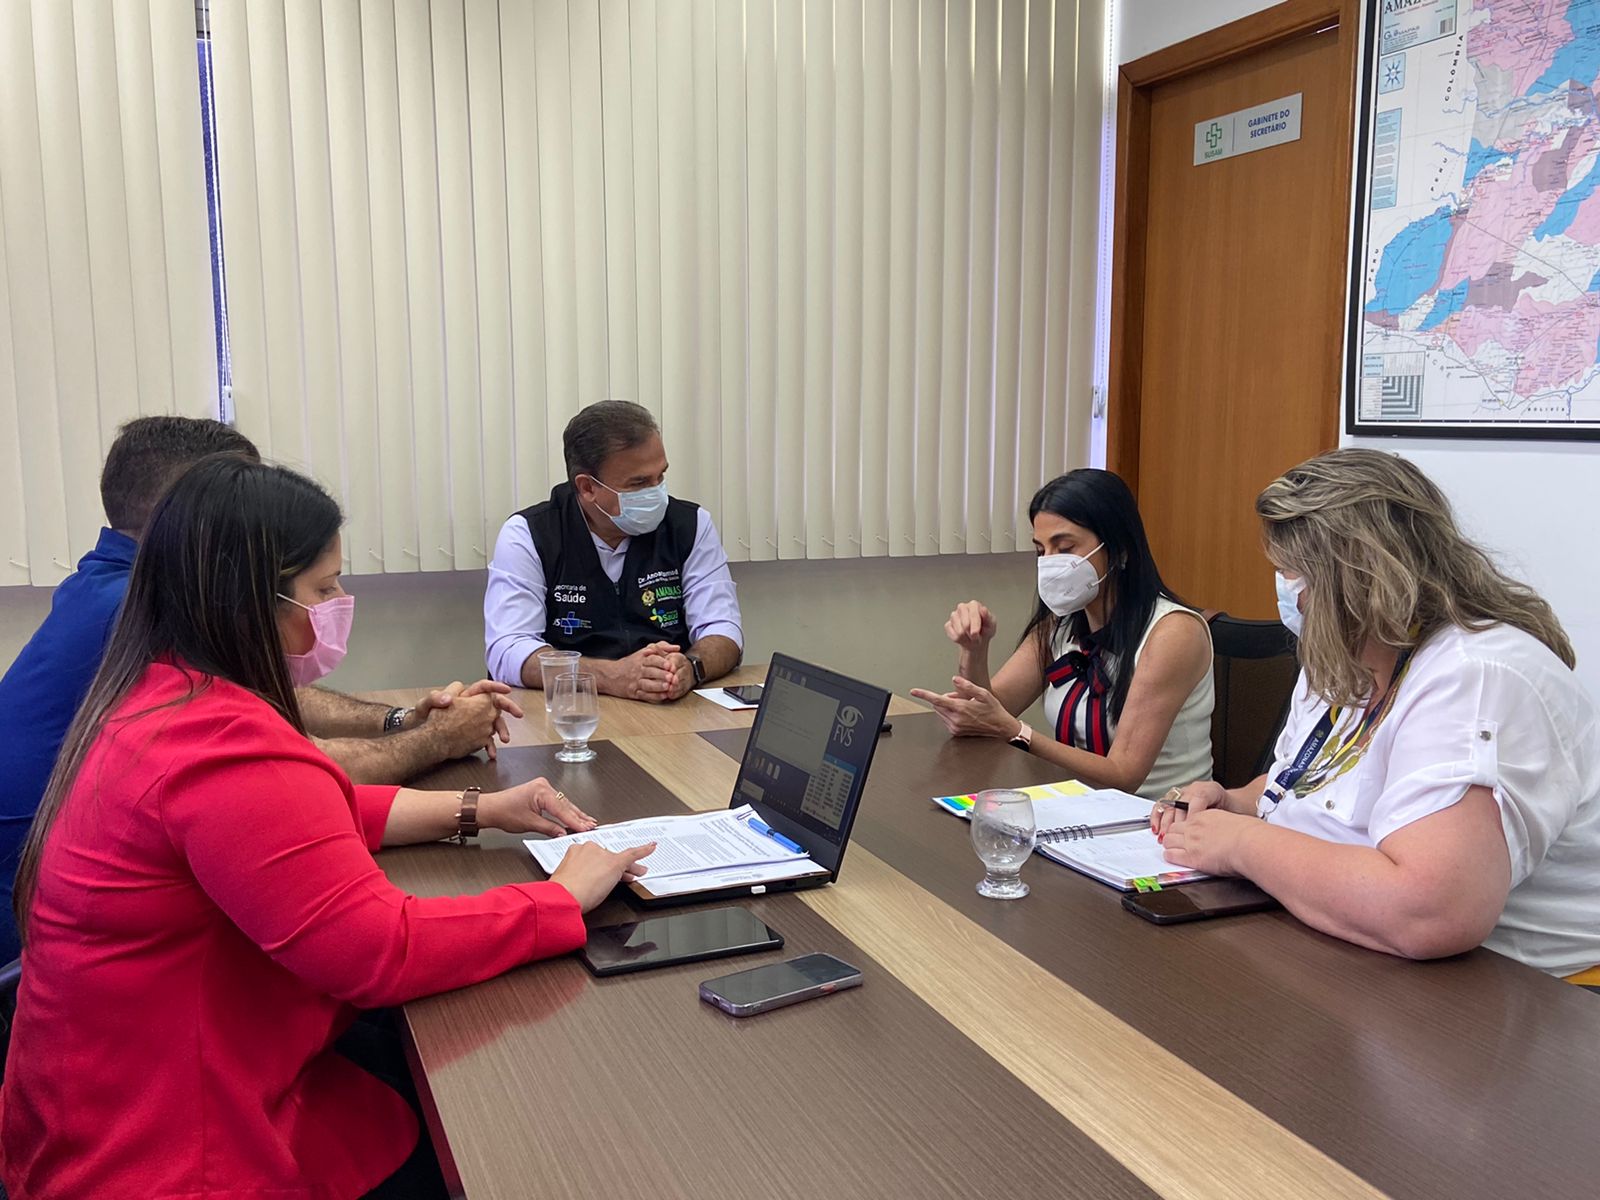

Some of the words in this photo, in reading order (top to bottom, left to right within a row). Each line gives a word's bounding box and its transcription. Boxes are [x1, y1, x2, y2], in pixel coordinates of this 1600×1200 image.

[1444, 35, 1464, 101] COLOMBIA
[1247, 111, 1279, 127] GABINETE
[1280, 109, 1290, 119] DO
[554, 590, 587, 603] Saúde
[833, 723, 855, 747] FVS
